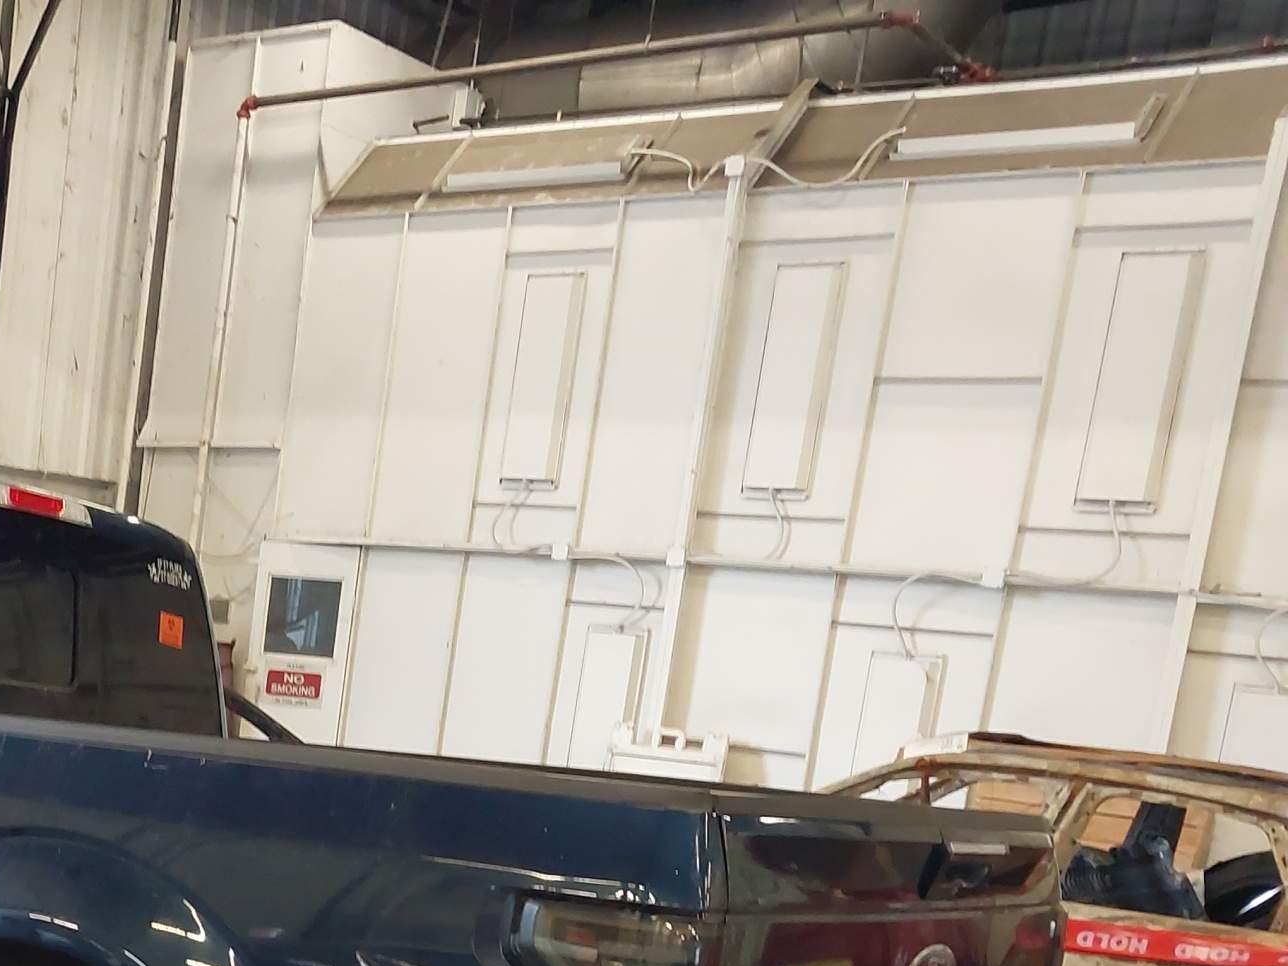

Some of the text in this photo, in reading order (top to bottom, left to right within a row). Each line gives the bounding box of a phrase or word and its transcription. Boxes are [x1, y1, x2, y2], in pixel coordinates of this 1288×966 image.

[284, 671, 305, 685] NO
[271, 682, 316, 697] SMOKING
[1075, 931, 1251, 963] HOLD HOLD
